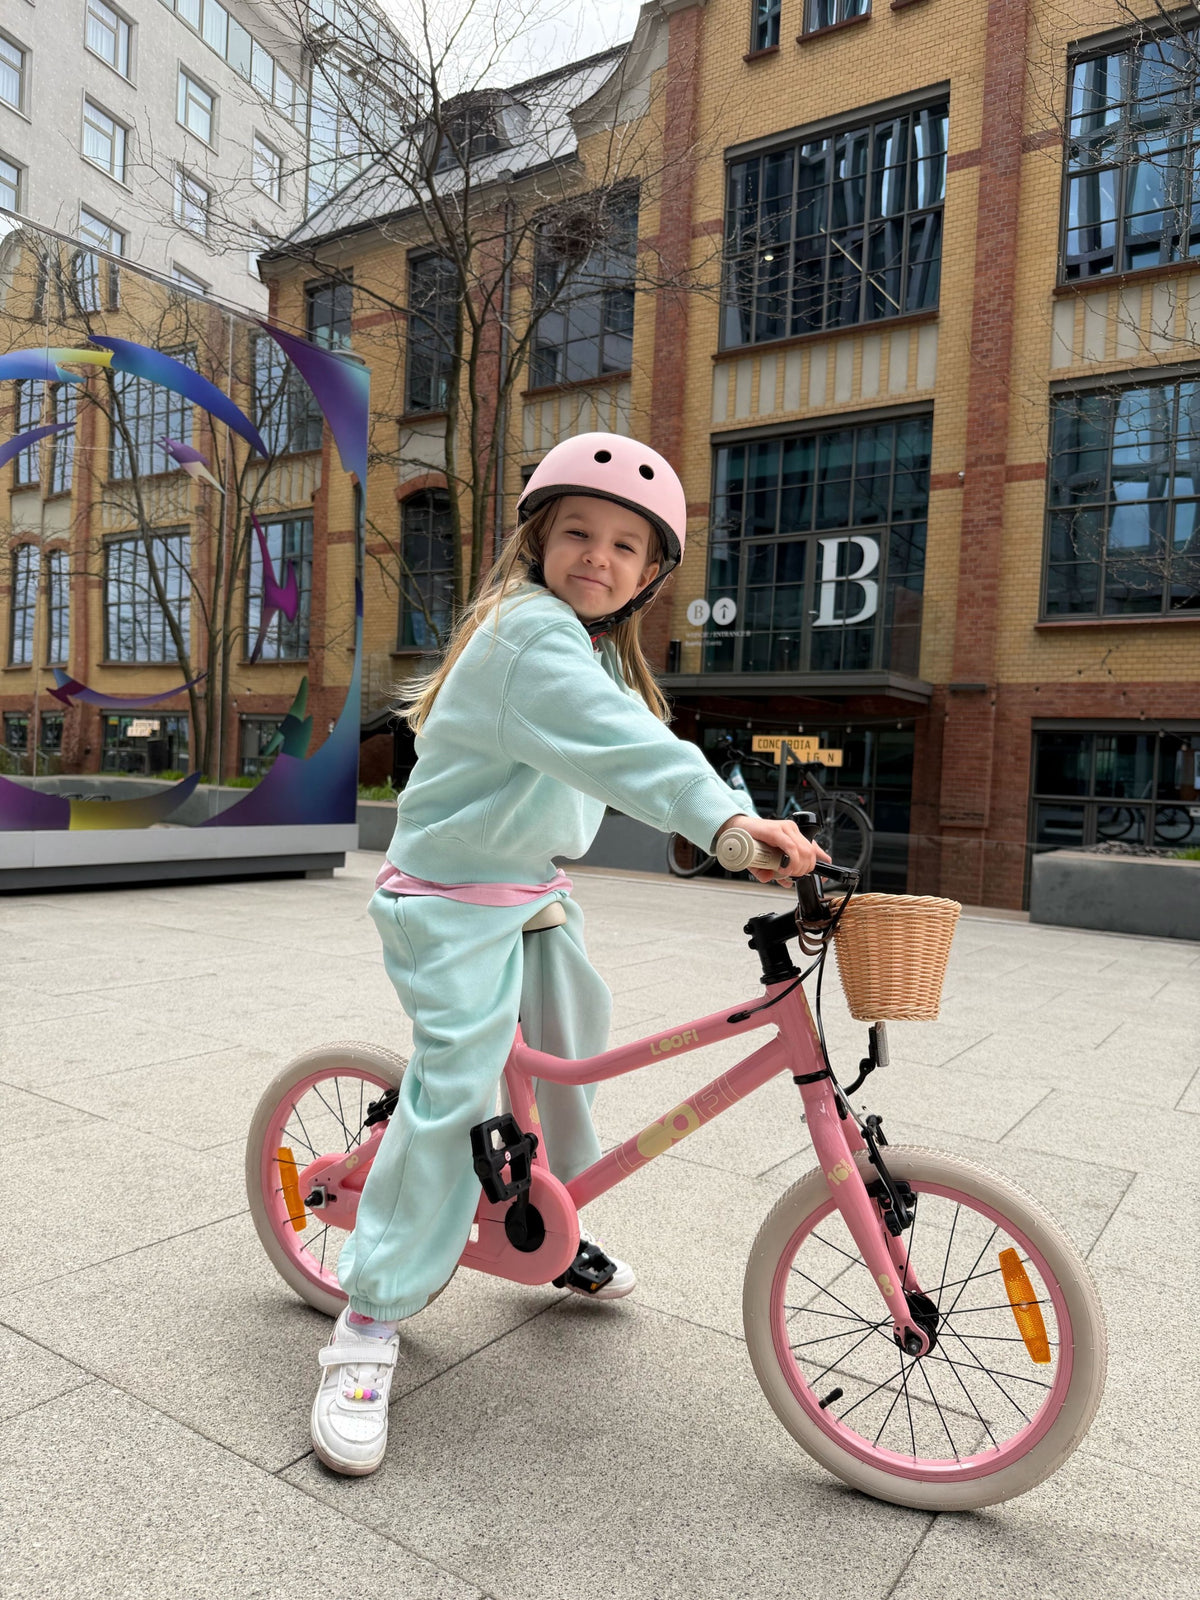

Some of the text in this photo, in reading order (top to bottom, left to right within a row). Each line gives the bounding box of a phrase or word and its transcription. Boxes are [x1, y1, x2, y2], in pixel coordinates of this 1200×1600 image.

[812, 535, 880, 627] B
[694, 604, 704, 620] B
[757, 739, 812, 750] CONCRDIA
[650, 1029, 699, 1056] LOOFI
[827, 1163, 849, 1186] 16
